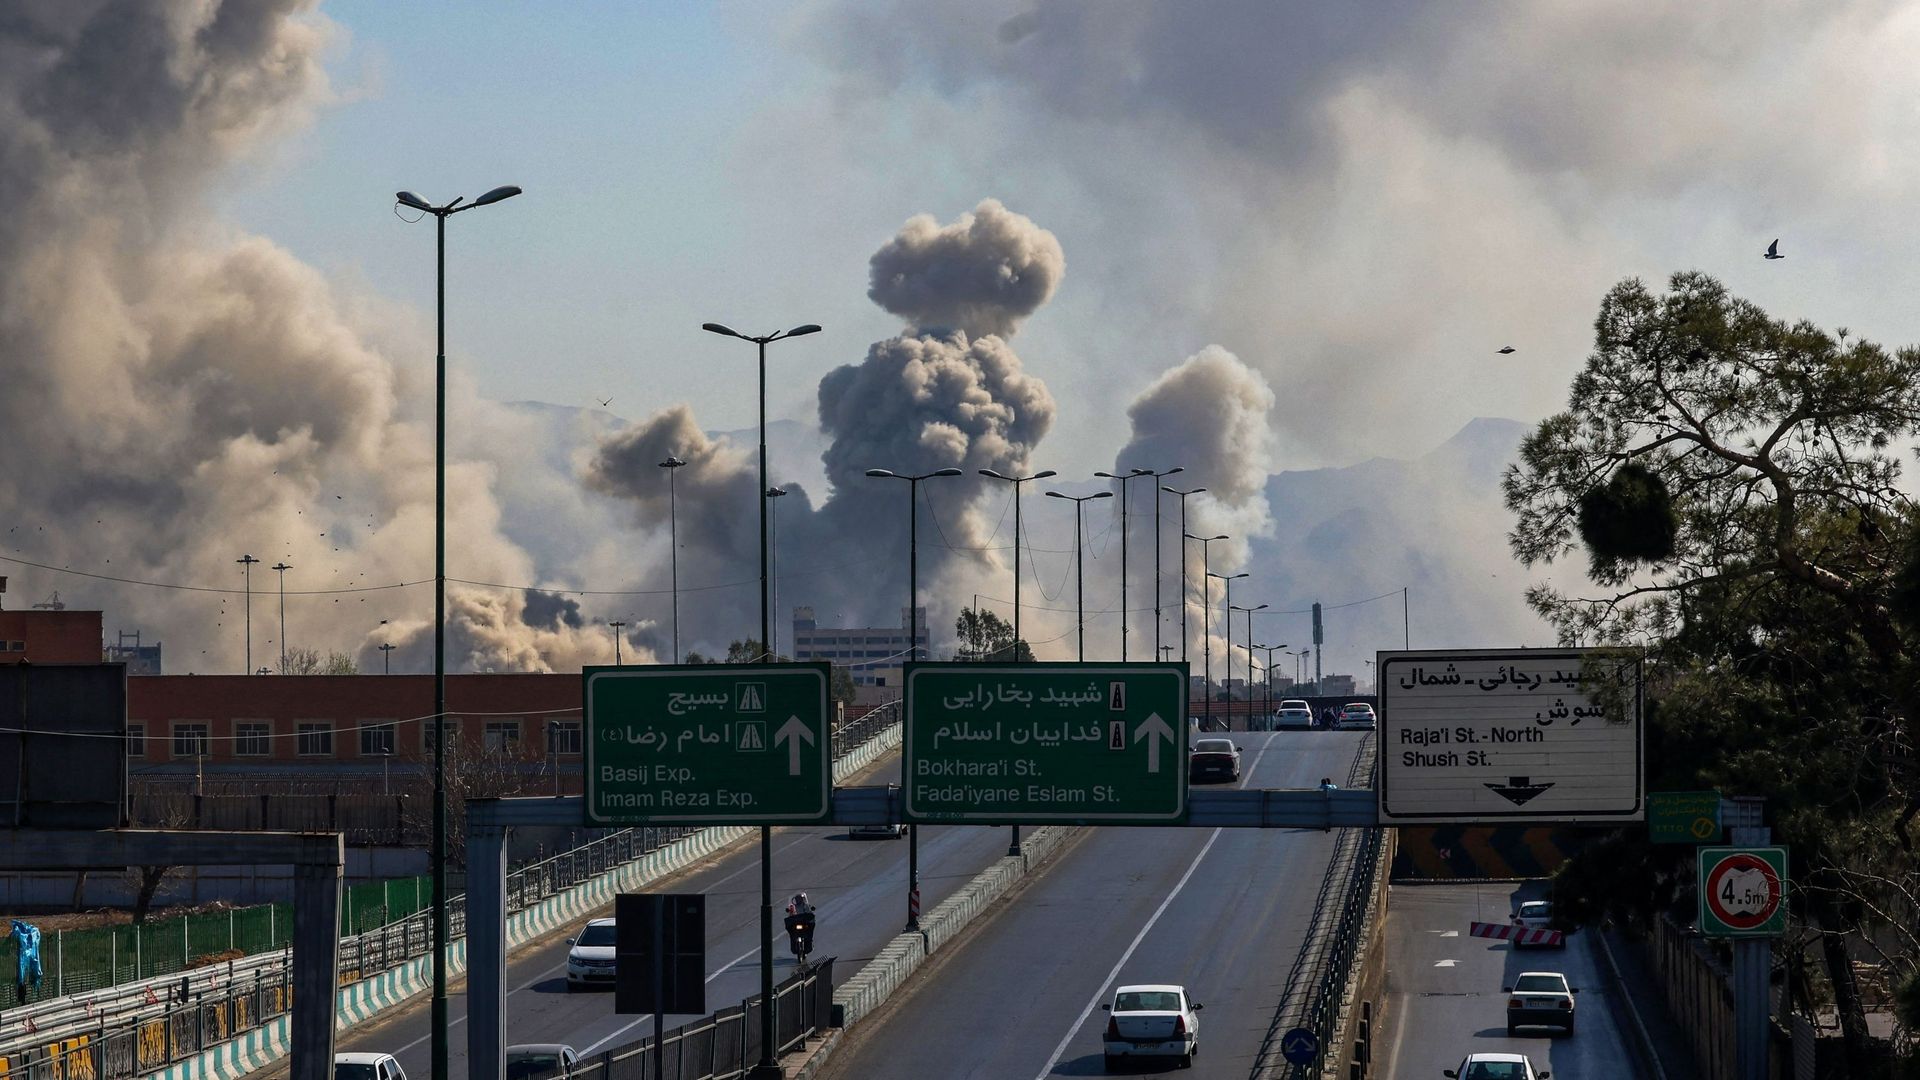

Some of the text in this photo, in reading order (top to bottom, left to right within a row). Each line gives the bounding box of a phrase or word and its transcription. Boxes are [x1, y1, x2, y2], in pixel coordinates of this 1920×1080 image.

[668, 692, 729, 716] بسیج
[943, 682, 1102, 711] شهید بخارایی
[677, 723, 729, 753] امام
[933, 720, 1102, 750] فداییان اسلام
[1401, 727, 1450, 747] Raja'i
[917, 760, 1042, 776] Bokhara'i St.
[1402, 750, 1493, 767] Shush St.
[601, 765, 697, 785] Basij Exp.
[601, 789, 759, 808] Imam Reza Exp.
[917, 785, 1121, 805] Fada'iyane Eslam St.
[1721, 878, 1765, 905] 4.5m
